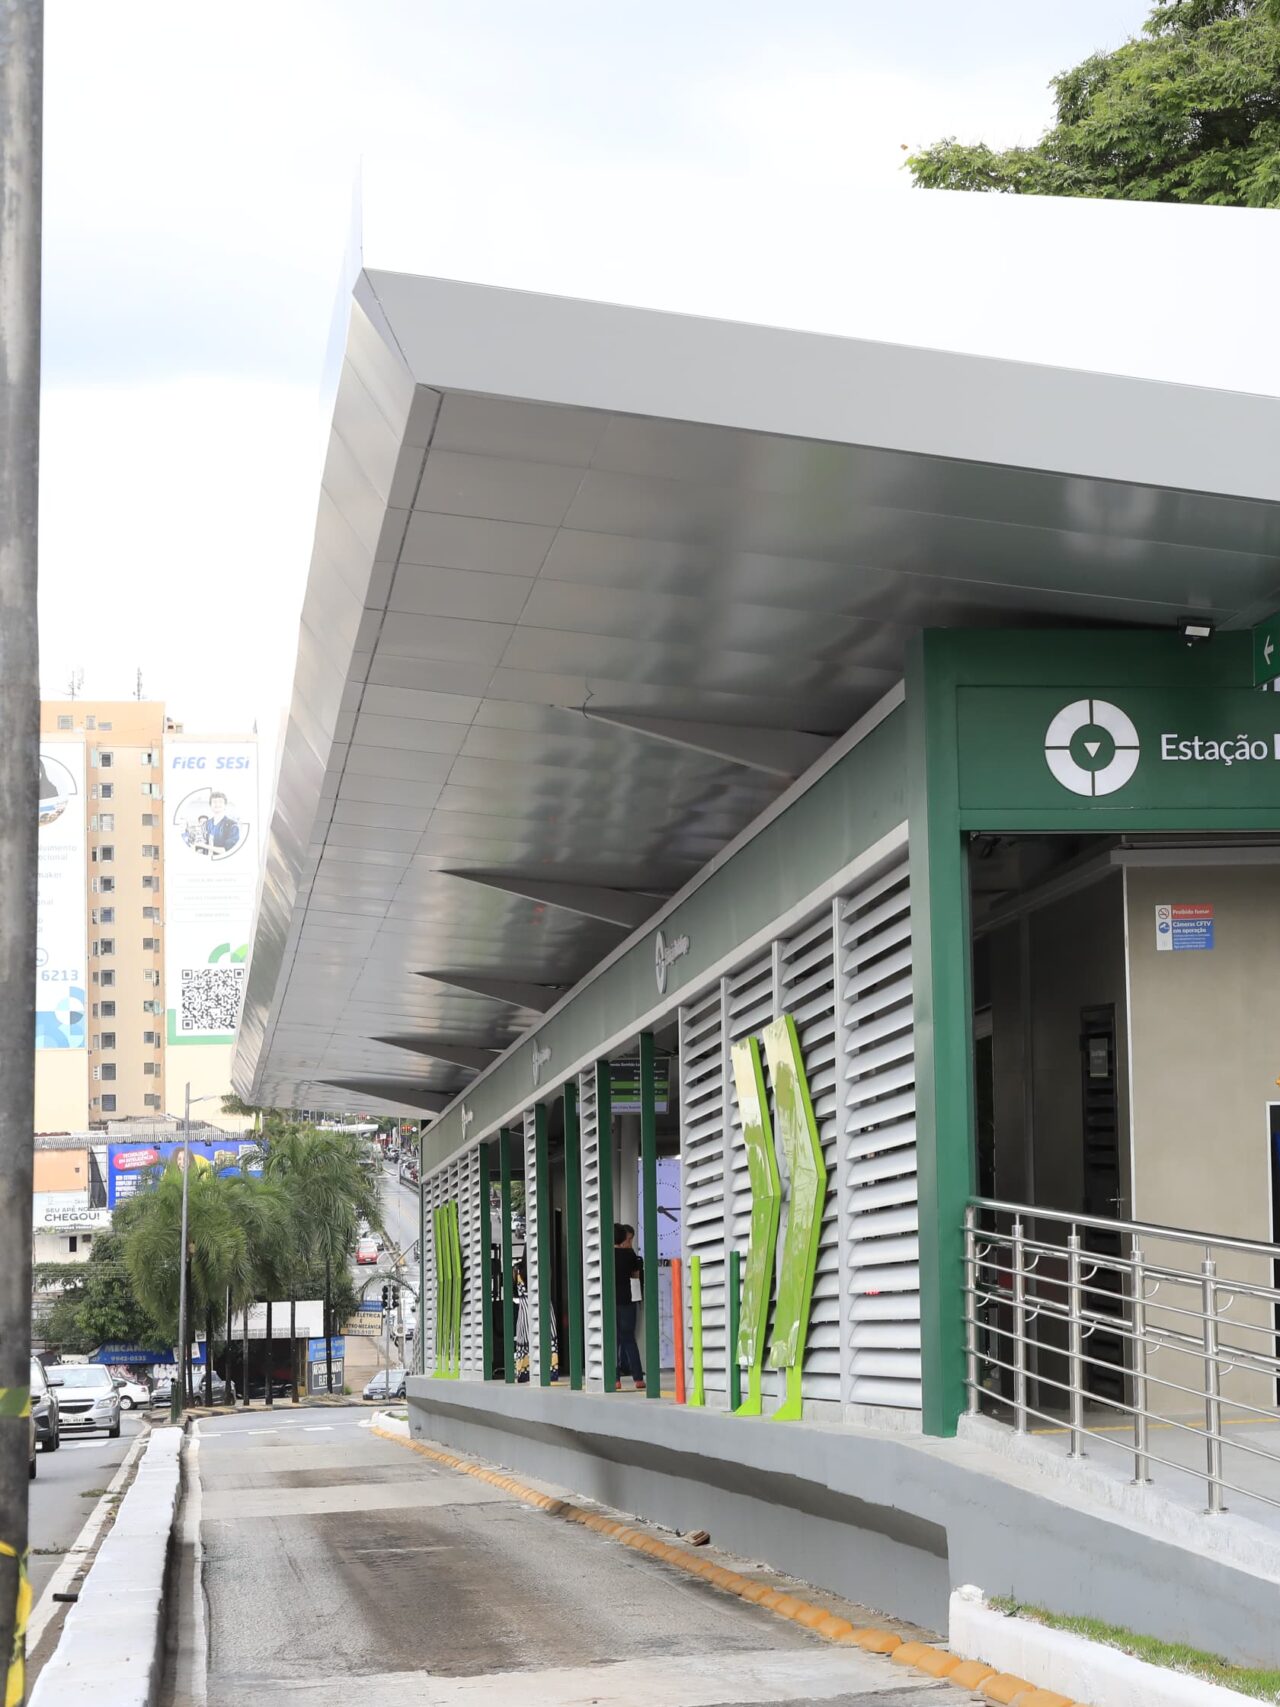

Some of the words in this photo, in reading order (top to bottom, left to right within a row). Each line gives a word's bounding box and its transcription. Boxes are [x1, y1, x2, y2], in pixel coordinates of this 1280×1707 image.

[1160, 733, 1268, 766] Estação
[41, 970, 79, 981] 6213
[44, 1212, 100, 1222] CHEGOU!
